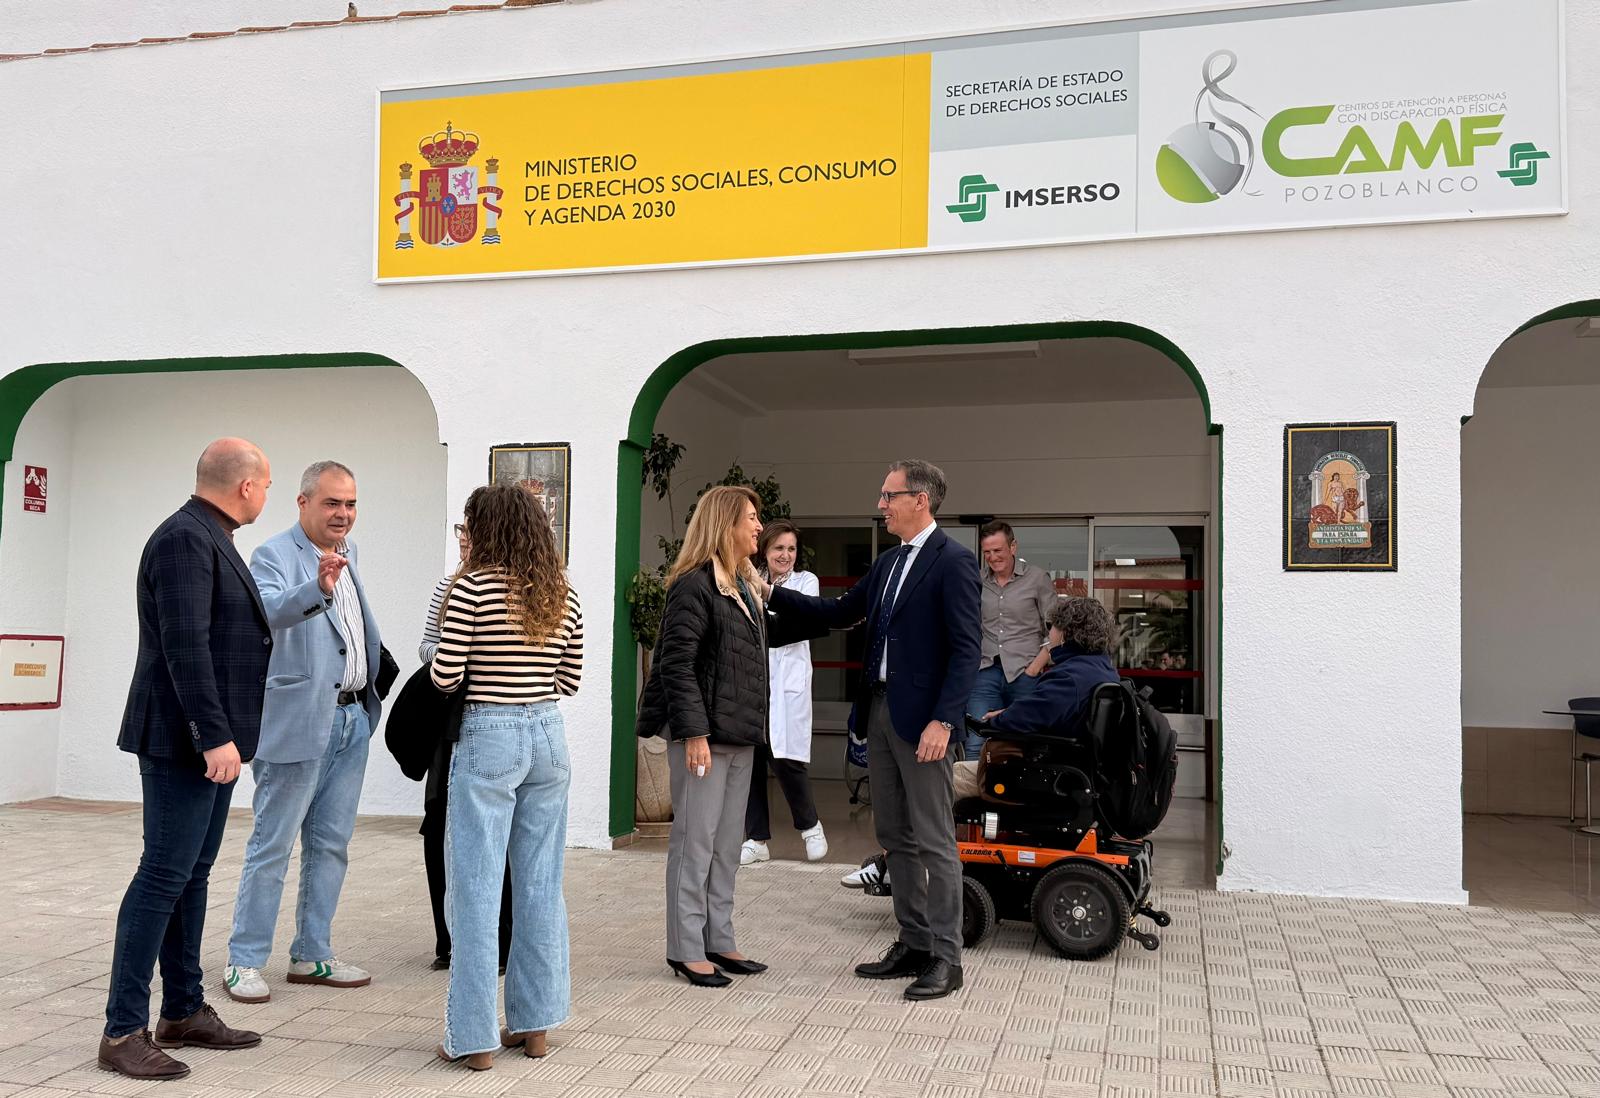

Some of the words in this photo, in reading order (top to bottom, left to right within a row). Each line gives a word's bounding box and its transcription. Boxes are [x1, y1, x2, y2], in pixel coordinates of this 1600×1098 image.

[946, 76, 1033, 97] SECRETARÍA
[1038, 76, 1058, 89] DE
[1063, 70, 1123, 86] ESTADO
[946, 104, 965, 117] DE
[970, 97, 1051, 115] DERECHOS
[1055, 89, 1128, 107] SOCIALES
[1337, 102, 1379, 112] CENTROS
[1382, 100, 1393, 109] DE
[1397, 96, 1445, 107] ATENCIÓN
[1458, 92, 1507, 103] PERSONAS
[1337, 113, 1367, 123] CON
[1371, 106, 1465, 121] DISCAPACIDAD
[1469, 102, 1508, 113] FÍSICA
[1262, 105, 1505, 178] CAMF
[525, 154, 637, 177] MINISTERIO
[525, 185, 550, 202] DE
[557, 176, 665, 200] DERECHOS
[672, 168, 773, 192] SOCIALES,
[779, 158, 897, 183] CONSUMO
[1285, 176, 1478, 203] POZOBLANCO
[1005, 182, 1120, 208] IMSERSO
[524, 209, 536, 226] Y
[540, 204, 626, 225] AGENDA
[632, 200, 676, 220] 2030
